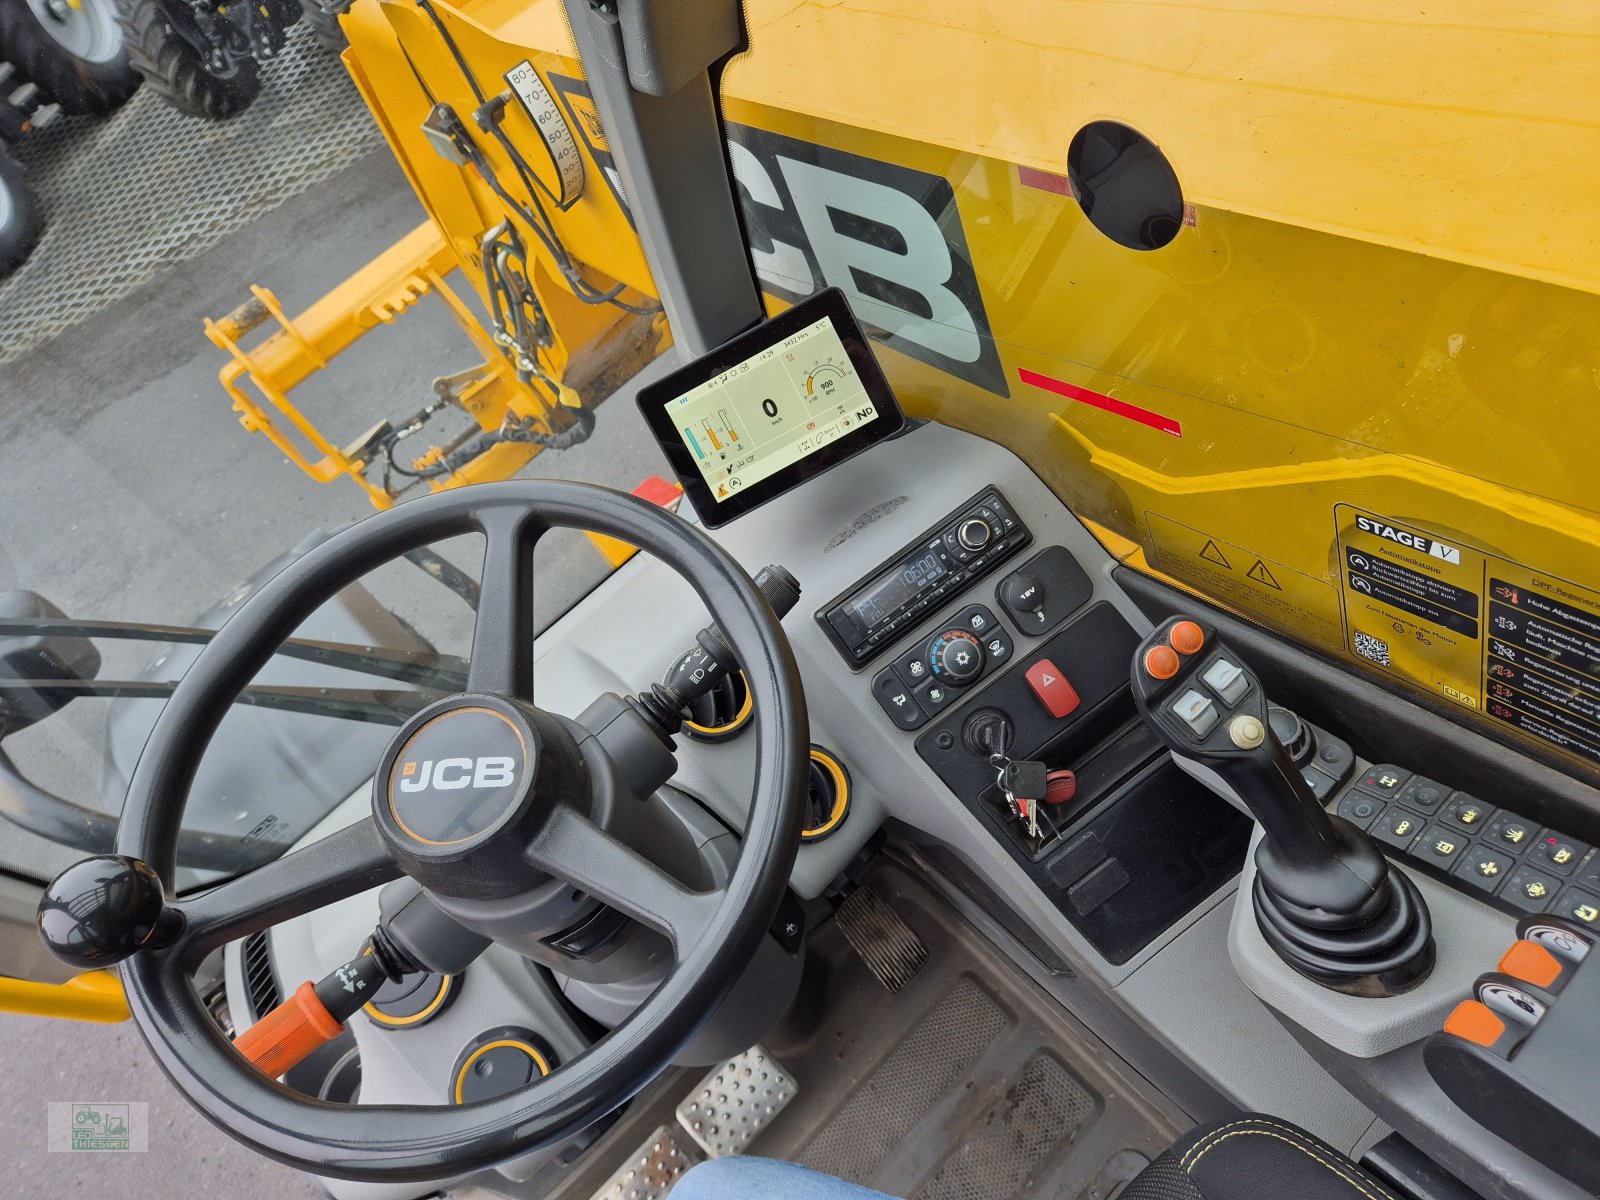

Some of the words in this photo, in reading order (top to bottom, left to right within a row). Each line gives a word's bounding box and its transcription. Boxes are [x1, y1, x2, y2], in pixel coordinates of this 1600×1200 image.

[511, 69, 527, 84] 80
[525, 90, 540, 105] 70
[538, 111, 552, 125] 60
[548, 130, 562, 144] 50
[557, 147, 570, 160] 40
[563, 163, 575, 175] 30
[820, 379, 834, 391] 900
[762, 398, 778, 419] 0
[1357, 516, 1426, 552] STAGE
[1440, 545, 1453, 559] V
[1379, 546, 1442, 575] Automatikstopp
[1019, 585, 1036, 601] 12V
[1374, 587, 1427, 612] Automatikstopp
[1427, 608, 1440, 617] aus
[1527, 597, 1550, 611] Hohe
[1527, 620, 1583, 646] Automatische
[1525, 637, 1561, 657] bedienen
[1547, 637, 1586, 657] Maschine
[400, 756, 515, 793] JCB
